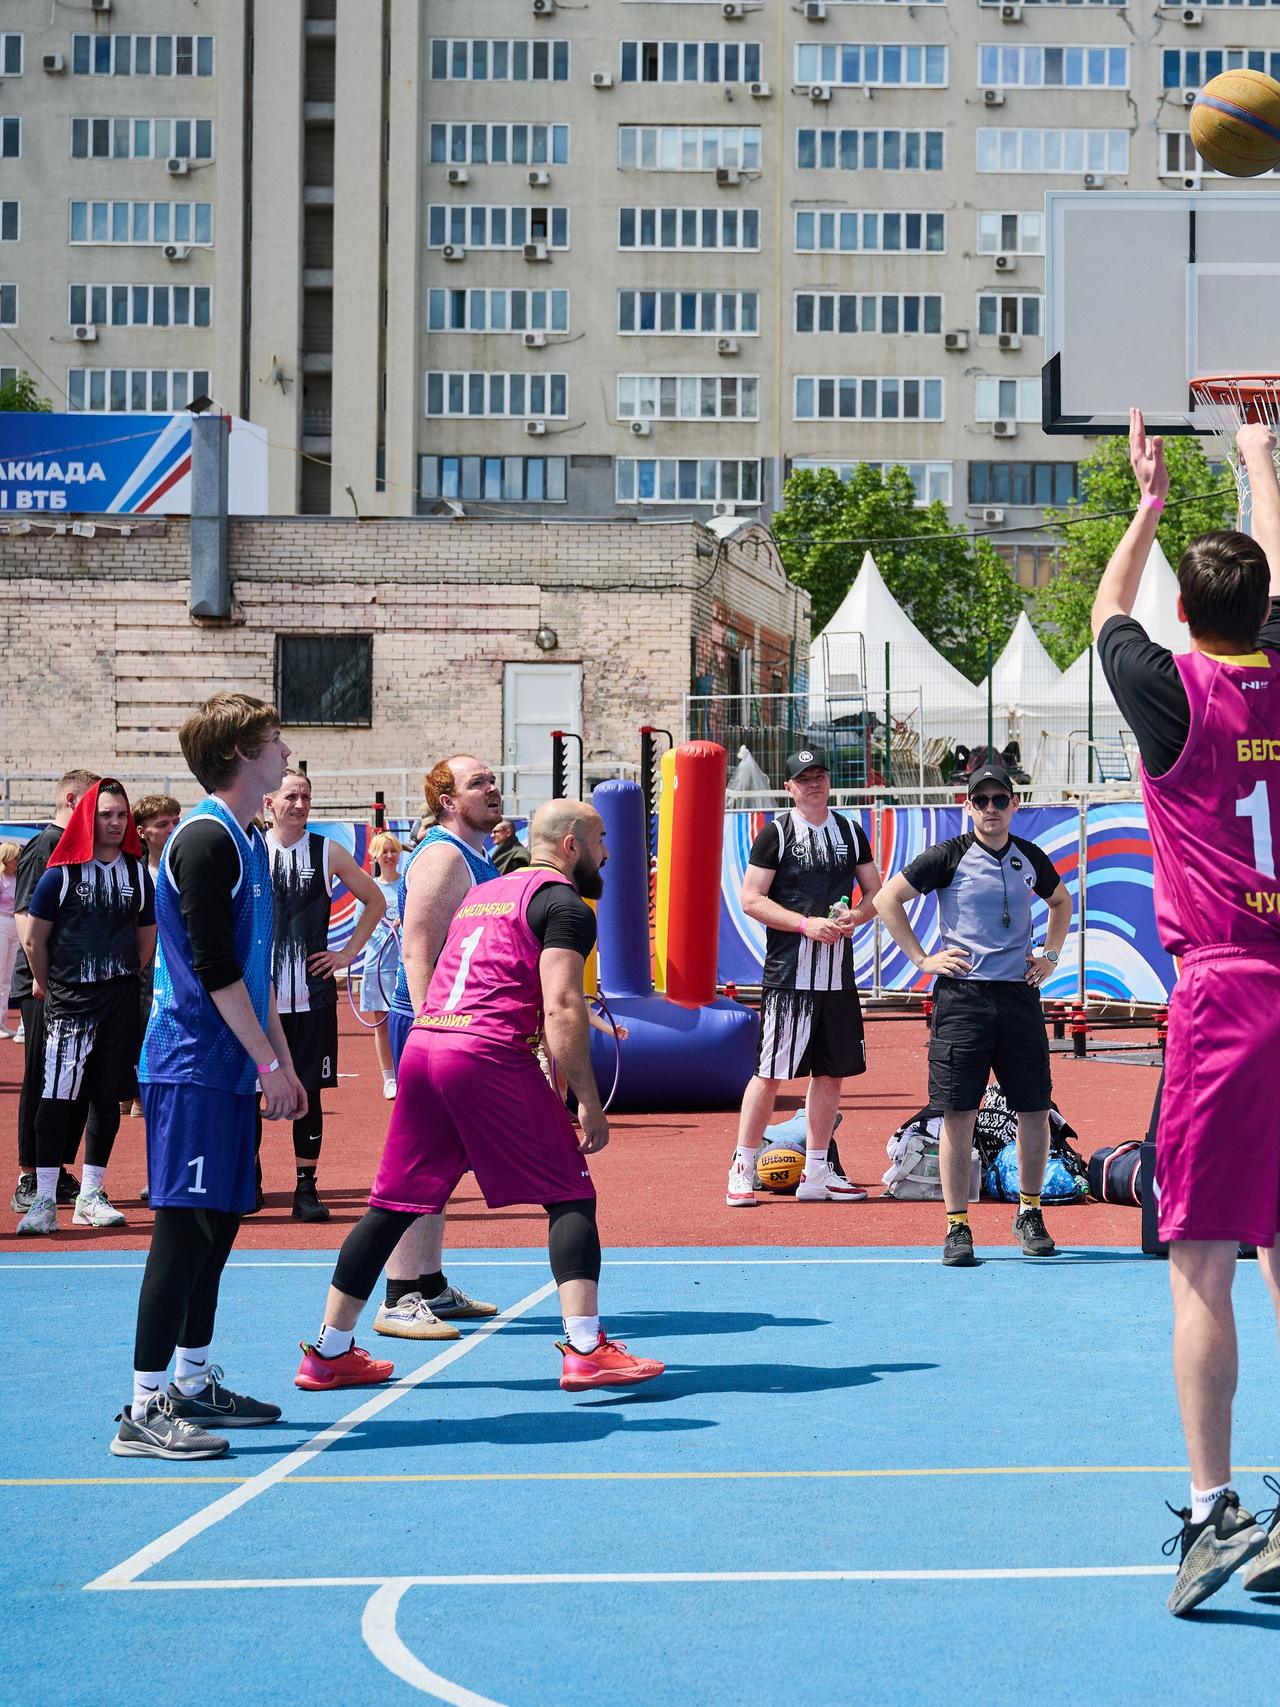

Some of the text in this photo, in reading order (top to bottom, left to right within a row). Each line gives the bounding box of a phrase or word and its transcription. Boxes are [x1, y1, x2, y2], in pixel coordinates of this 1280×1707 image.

[16, 490, 68, 509] ВТБ
[443, 926, 485, 1011] 1
[321, 1055, 331, 1079] 8
[761, 1154, 797, 1166] Wilson
[187, 1155, 207, 1194] 1
